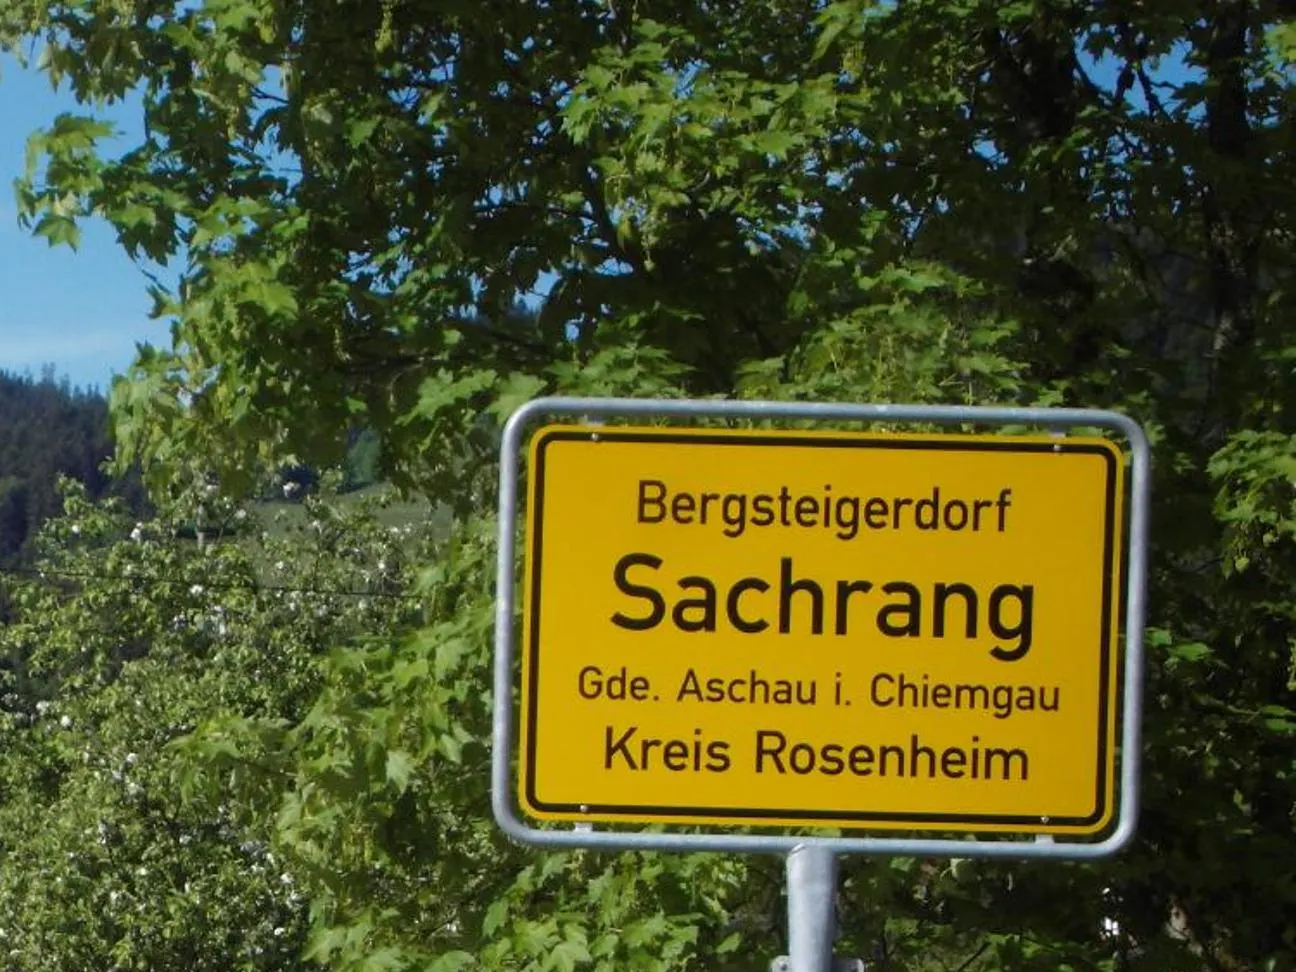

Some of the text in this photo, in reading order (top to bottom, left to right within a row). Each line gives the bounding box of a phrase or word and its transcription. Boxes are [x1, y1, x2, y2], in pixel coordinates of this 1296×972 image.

[636, 479, 1012, 540] Bergsteigerdorf
[610, 552, 1035, 662] Sachrang
[577, 665, 1061, 719] Gde. Aschau i. Chiemgau
[604, 726, 1030, 780] Kreis Rosenheim
